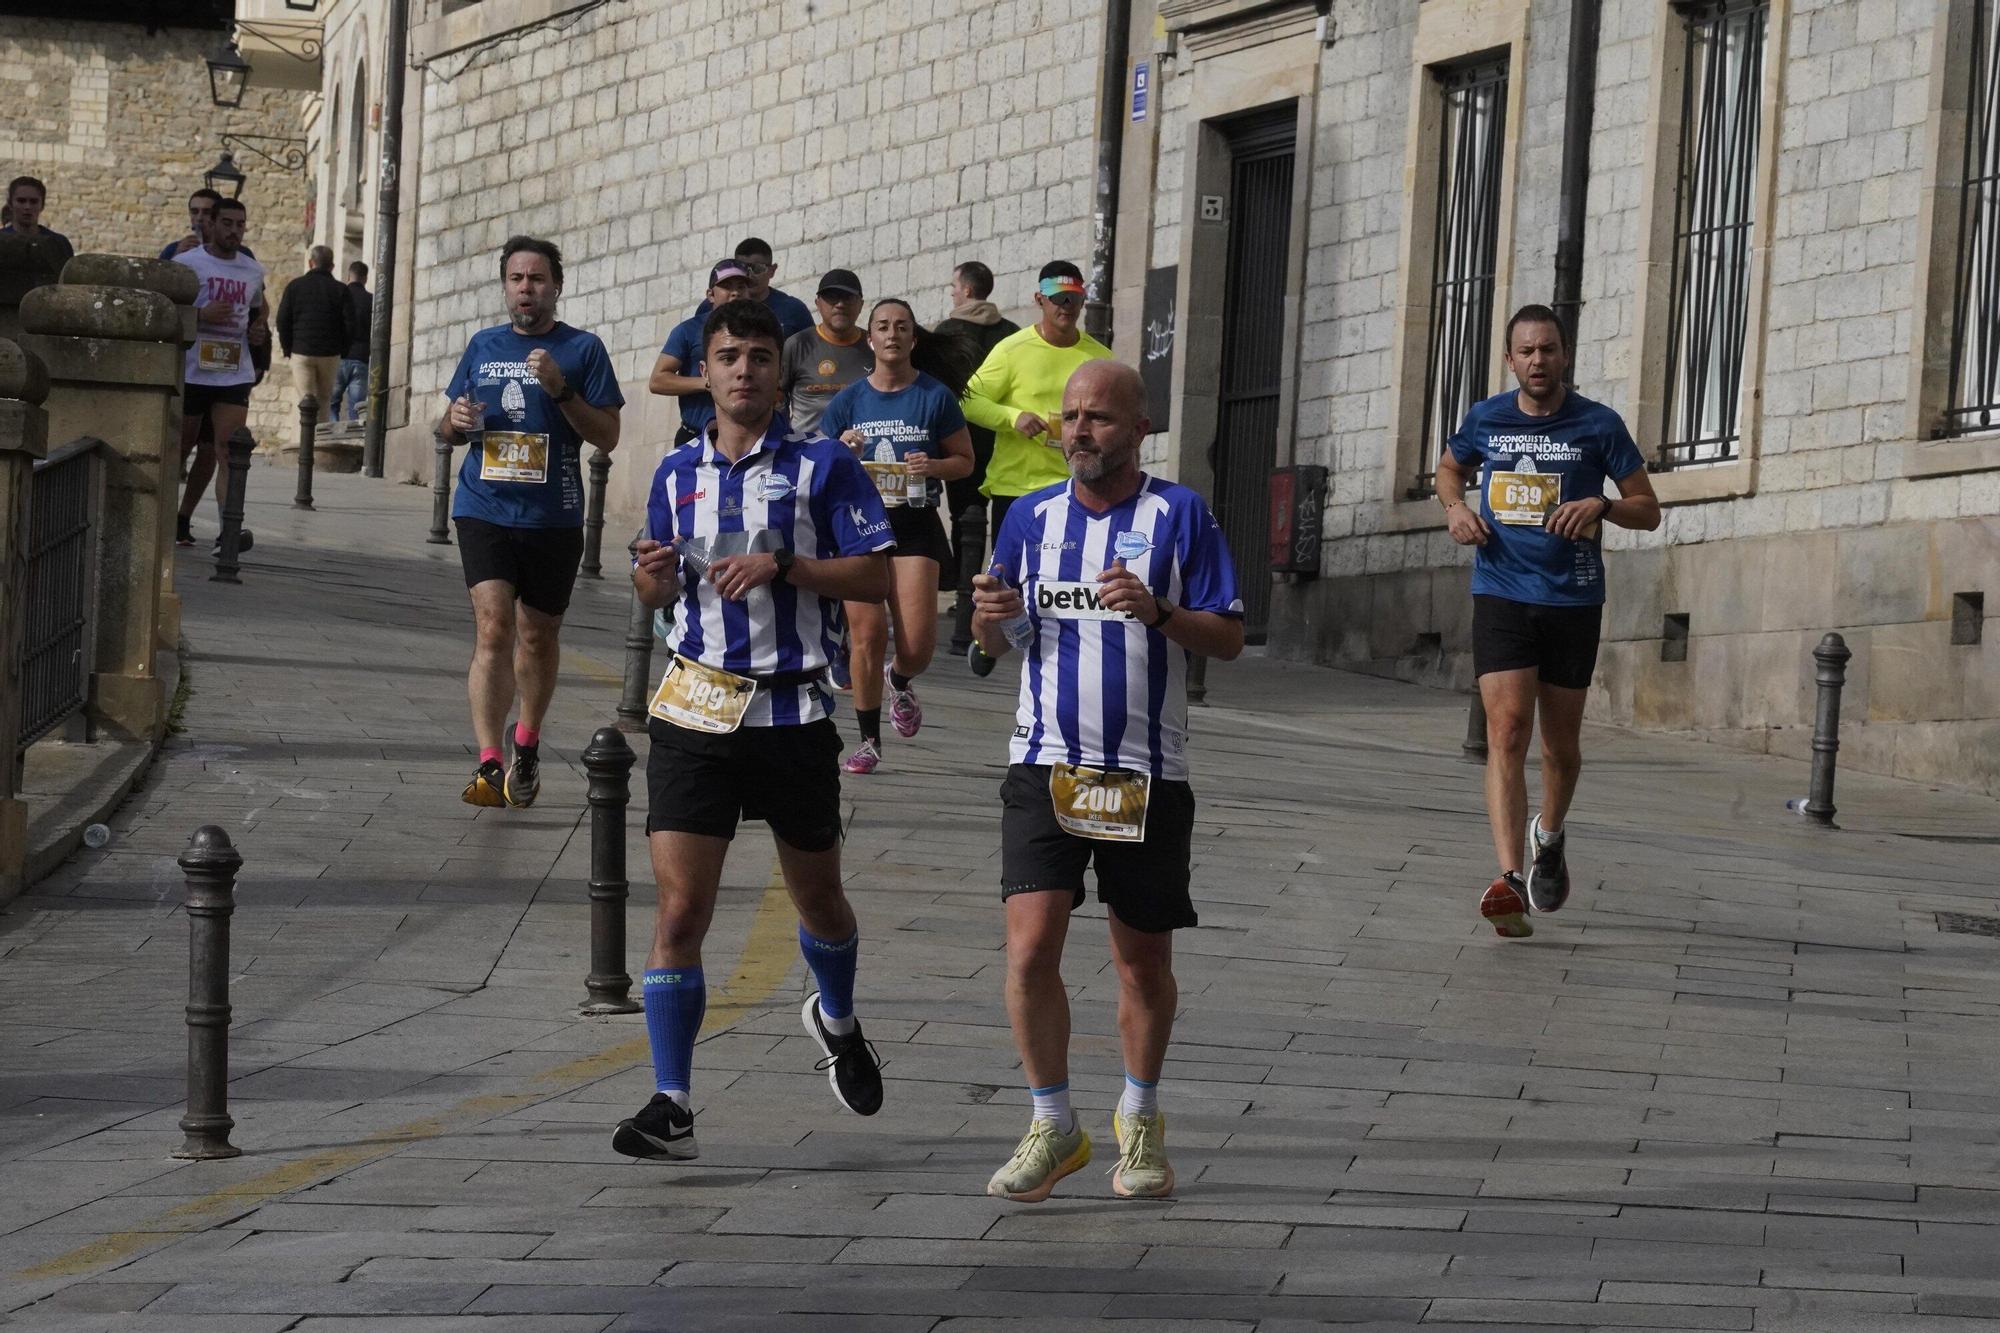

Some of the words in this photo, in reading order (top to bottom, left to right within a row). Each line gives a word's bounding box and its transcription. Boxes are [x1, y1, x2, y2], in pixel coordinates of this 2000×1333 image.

[489, 361, 527, 369] CONQUIS
[488, 368, 533, 378] ALMEN
[861, 419, 905, 430] CONQUISTA
[862, 425, 920, 437] ALMENDRA
[1489, 435, 1498, 443] LA
[1499, 434, 1551, 443] CONQUISTA
[497, 443, 530, 463] 264
[1499, 442, 1570, 453] ALMENDRA
[1536, 452, 1582, 461] KONKISTA
[876, 473, 905, 490] 507
[1505, 484, 1542, 506] 639
[686, 679, 726, 711] 199
[1072, 783, 1122, 813] 200
[1088, 813, 1103, 821] IKER
